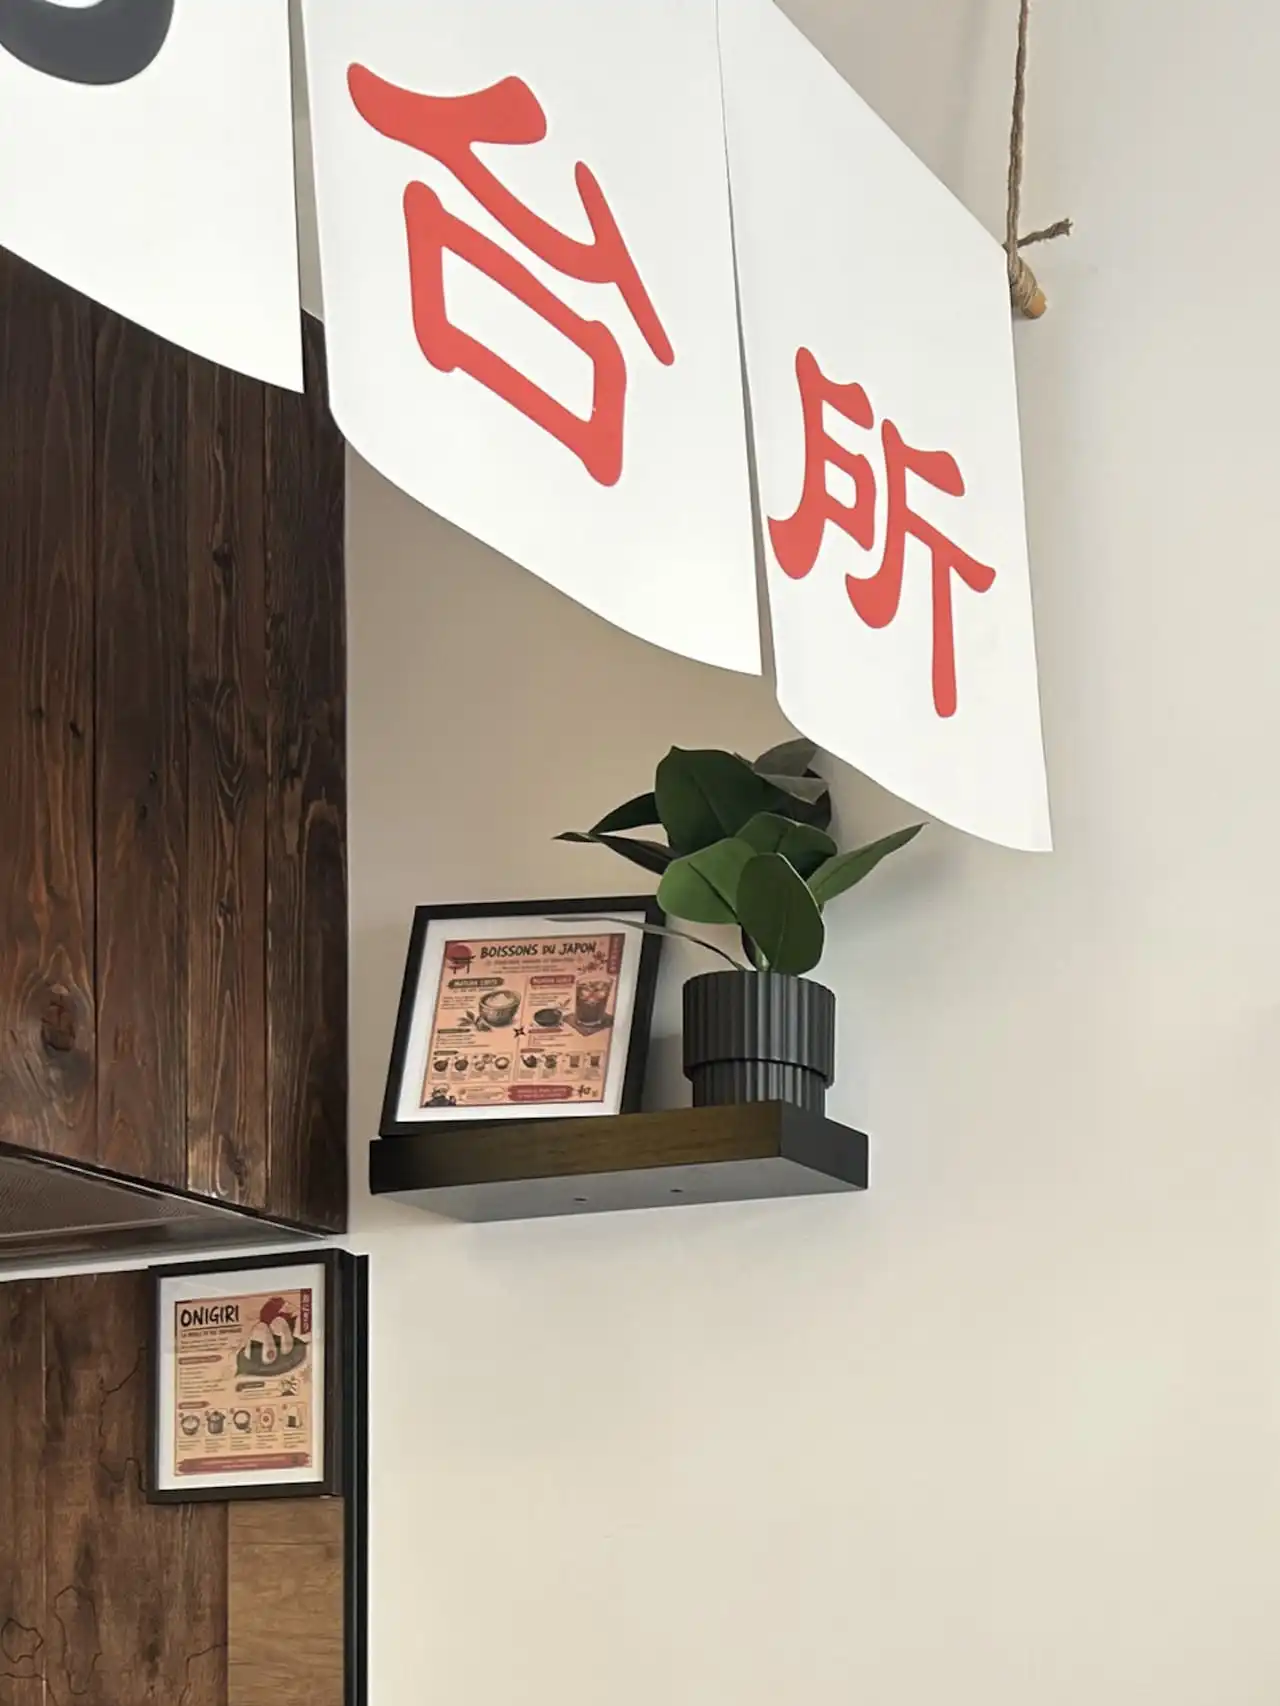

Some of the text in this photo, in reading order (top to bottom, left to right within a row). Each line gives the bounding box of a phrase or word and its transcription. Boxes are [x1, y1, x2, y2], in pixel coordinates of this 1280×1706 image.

[480, 942, 538, 959] BOISSONS
[542, 943, 557, 955] DU
[558, 941, 597, 956] JAPON
[180, 1305, 239, 1327] ONIGIRI
